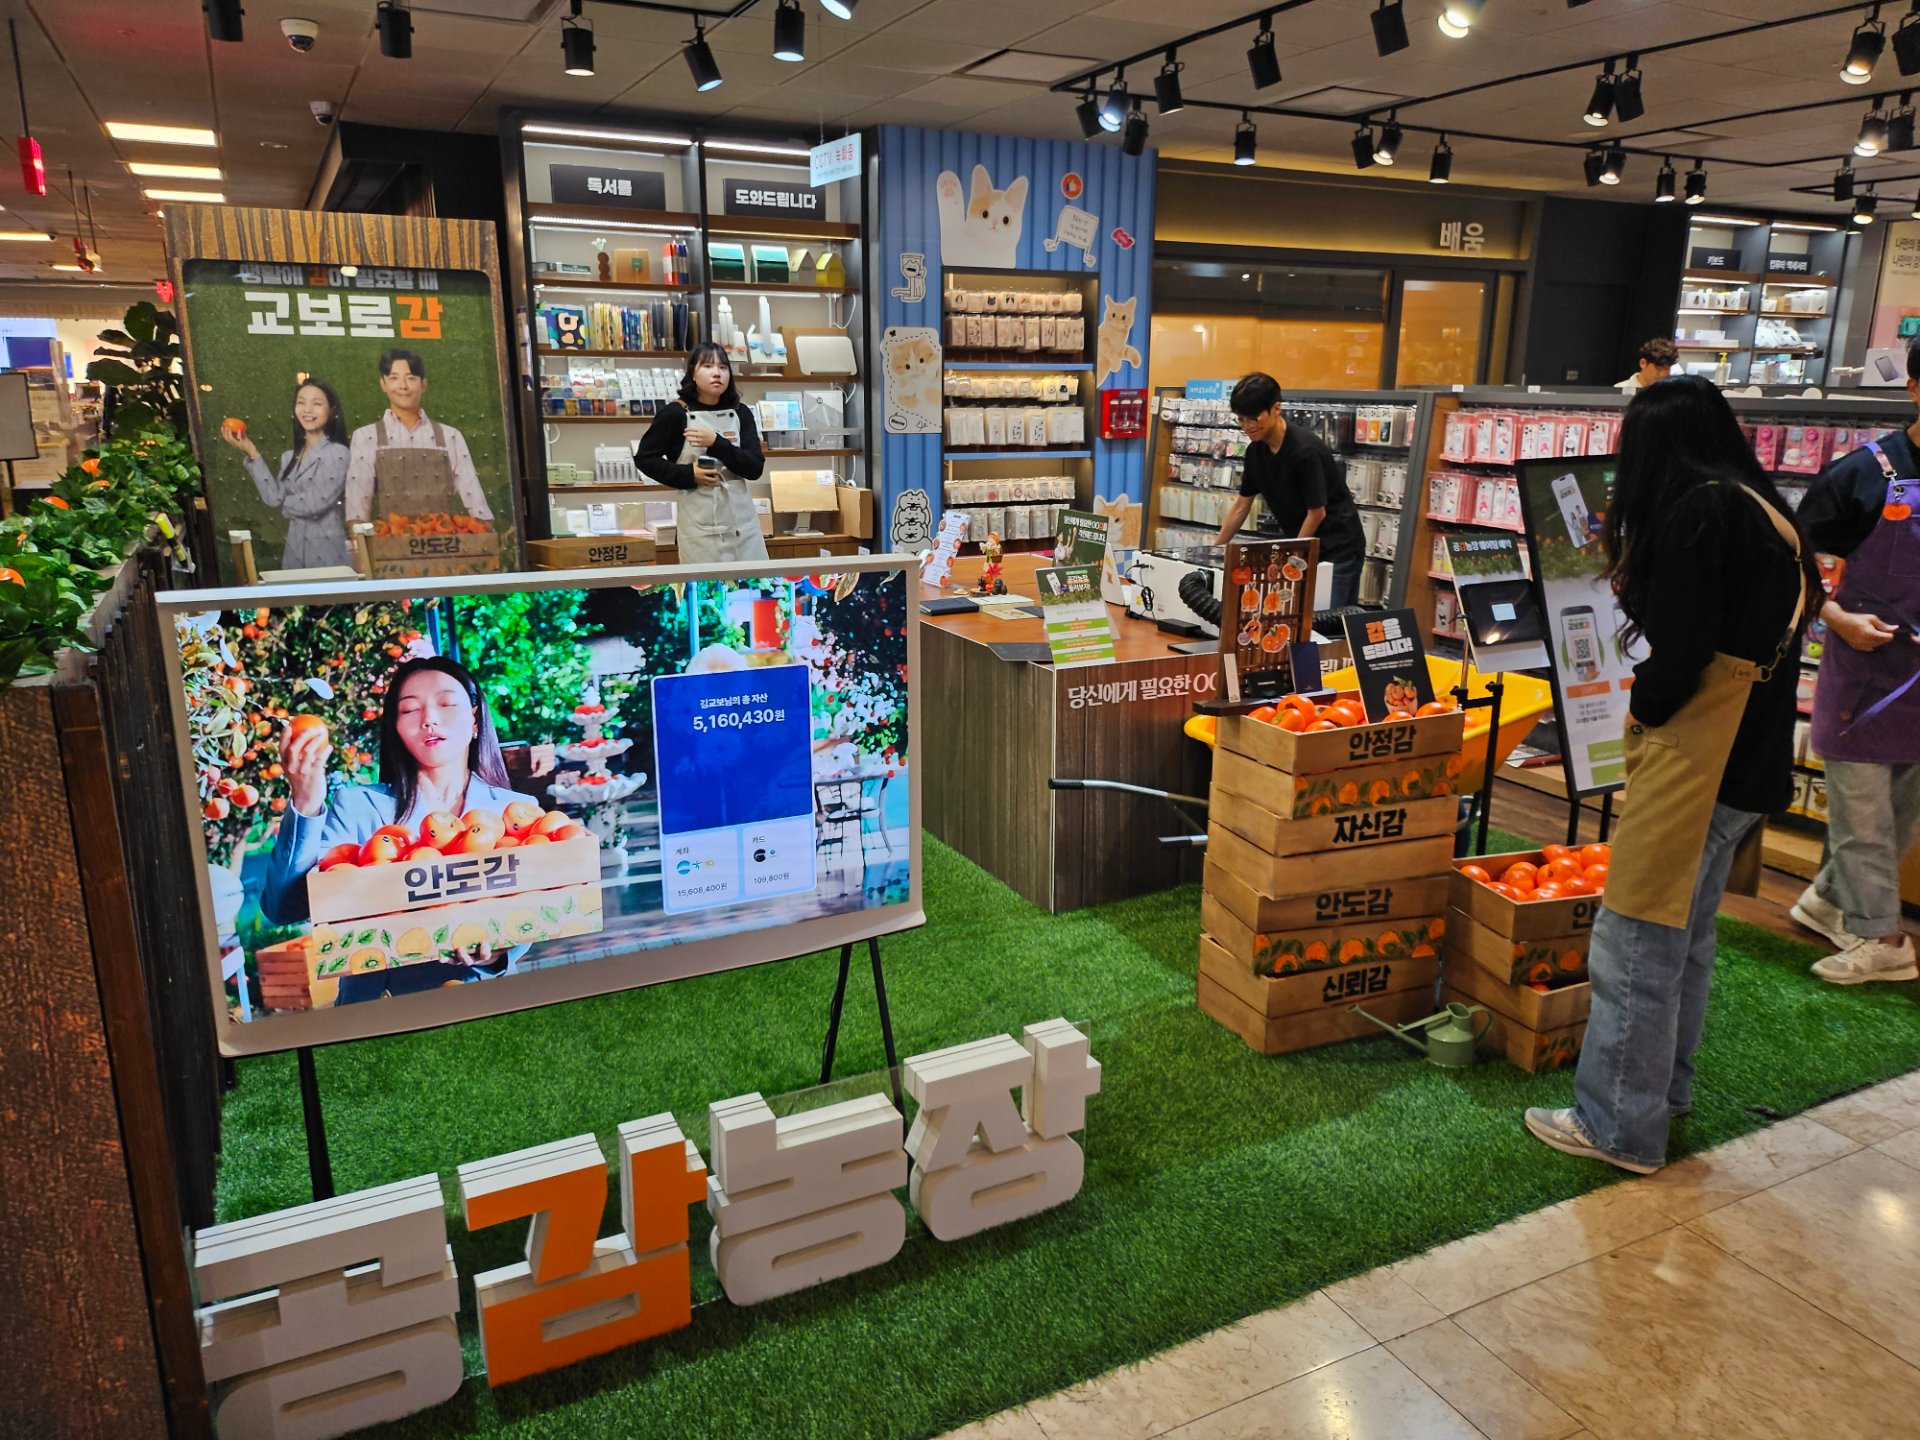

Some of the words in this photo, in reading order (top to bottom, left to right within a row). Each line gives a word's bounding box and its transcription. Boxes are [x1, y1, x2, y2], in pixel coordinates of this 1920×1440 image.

[815, 152, 833, 170] CCTV
[835, 144, 854, 164] 녹화중
[587, 177, 633, 197] 독서를
[735, 188, 817, 210] 도와드립니다
[1440, 221, 1485, 256] 배움
[239, 263, 303, 286] 생활에
[355, 267, 414, 290] 필요할
[419, 270, 439, 291] 때
[244, 291, 443, 339] 교보로감
[409, 536, 462, 555] 안도감
[588, 544, 628, 563] 안정감
[1366, 618, 1402, 643] 감을
[1362, 637, 1414, 660] 드립니다!
[699, 695, 741, 710] 김교보님의
[741, 694, 750, 706] 총
[751, 693, 768, 704] 자산
[1067, 680, 1138, 709] 당신에게
[1140, 674, 1192, 700] 필요한
[693, 709, 786, 733] 5,160,430원
[1349, 725, 1417, 761] 안정감
[1332, 808, 1408, 844] 자신감
[752, 834, 766, 844] 카드
[404, 853, 520, 903] 안도감
[677, 882, 728, 897] 15,608,400원
[753, 872, 790, 885] 109,800원
[1315, 887, 1394, 921] 안도감
[1322, 964, 1392, 1003] 신뢰감
[194, 1017, 1102, 1440] 공감농장
